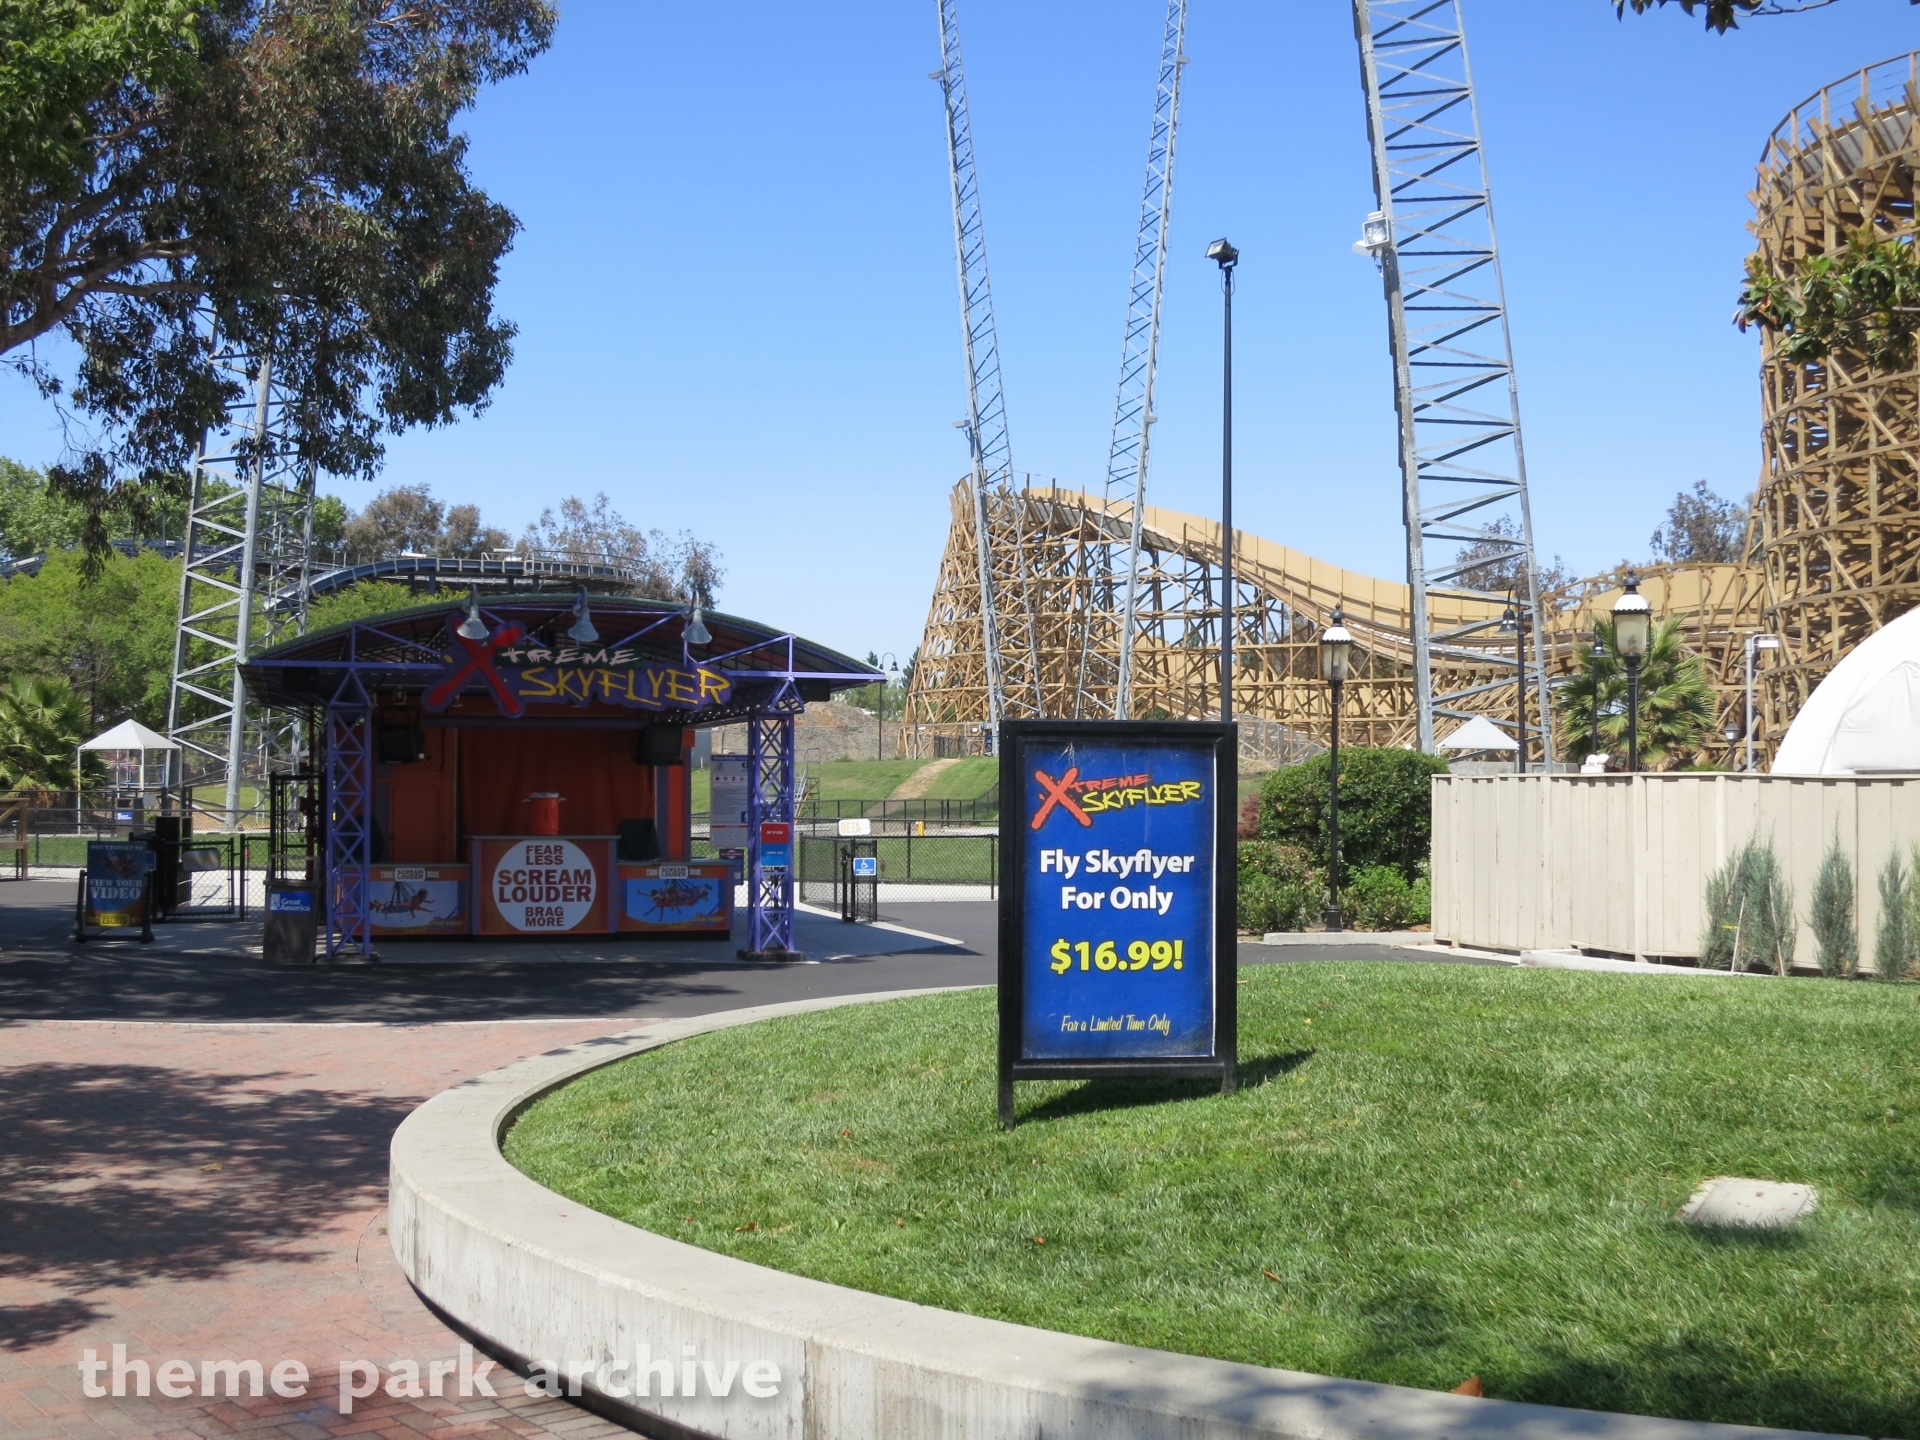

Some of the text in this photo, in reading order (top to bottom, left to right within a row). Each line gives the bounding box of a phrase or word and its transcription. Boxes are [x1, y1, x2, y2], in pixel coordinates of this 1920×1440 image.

[518, 666, 730, 706] SKYFLYER
[1082, 781, 1201, 812] SKYFLYER
[525, 845, 564, 855] FEAR
[525, 855, 564, 865] LESS
[1040, 849, 1195, 880] Fly Skyflyer
[89, 879, 143, 887] VIEW YOUR
[497, 869, 592, 886] SCREAM
[90, 887, 142, 899] VIDEO
[498, 885, 592, 903] LOUDER
[1061, 885, 1174, 916] For Only
[525, 906, 564, 918] BRAG
[525, 917, 565, 927] MORE
[1050, 938, 1184, 975] $16.99!
[1061, 1013, 1171, 1036] For a Limited Time Only
